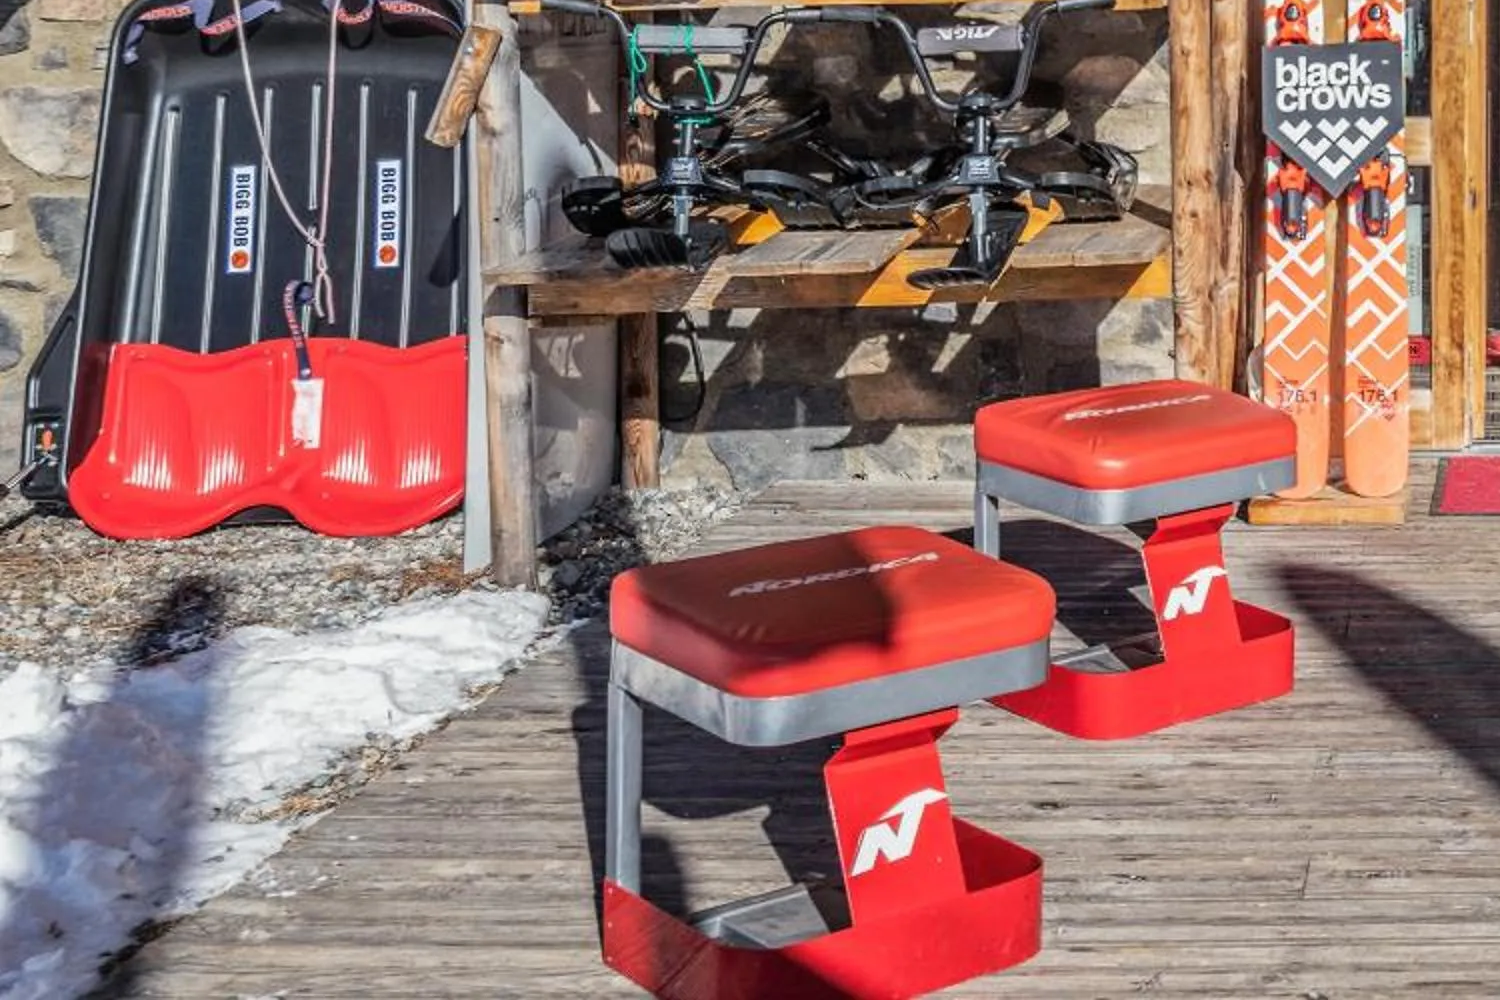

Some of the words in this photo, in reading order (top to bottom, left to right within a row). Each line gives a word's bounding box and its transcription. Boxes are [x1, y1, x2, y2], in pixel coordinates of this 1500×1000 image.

[1275, 53, 1372, 88] black
[1276, 83, 1393, 113] crows
[235, 173, 250, 210] BIGG
[381, 167, 397, 204] BIGG
[233, 216, 249, 247] BOB
[380, 210, 396, 241] BOB
